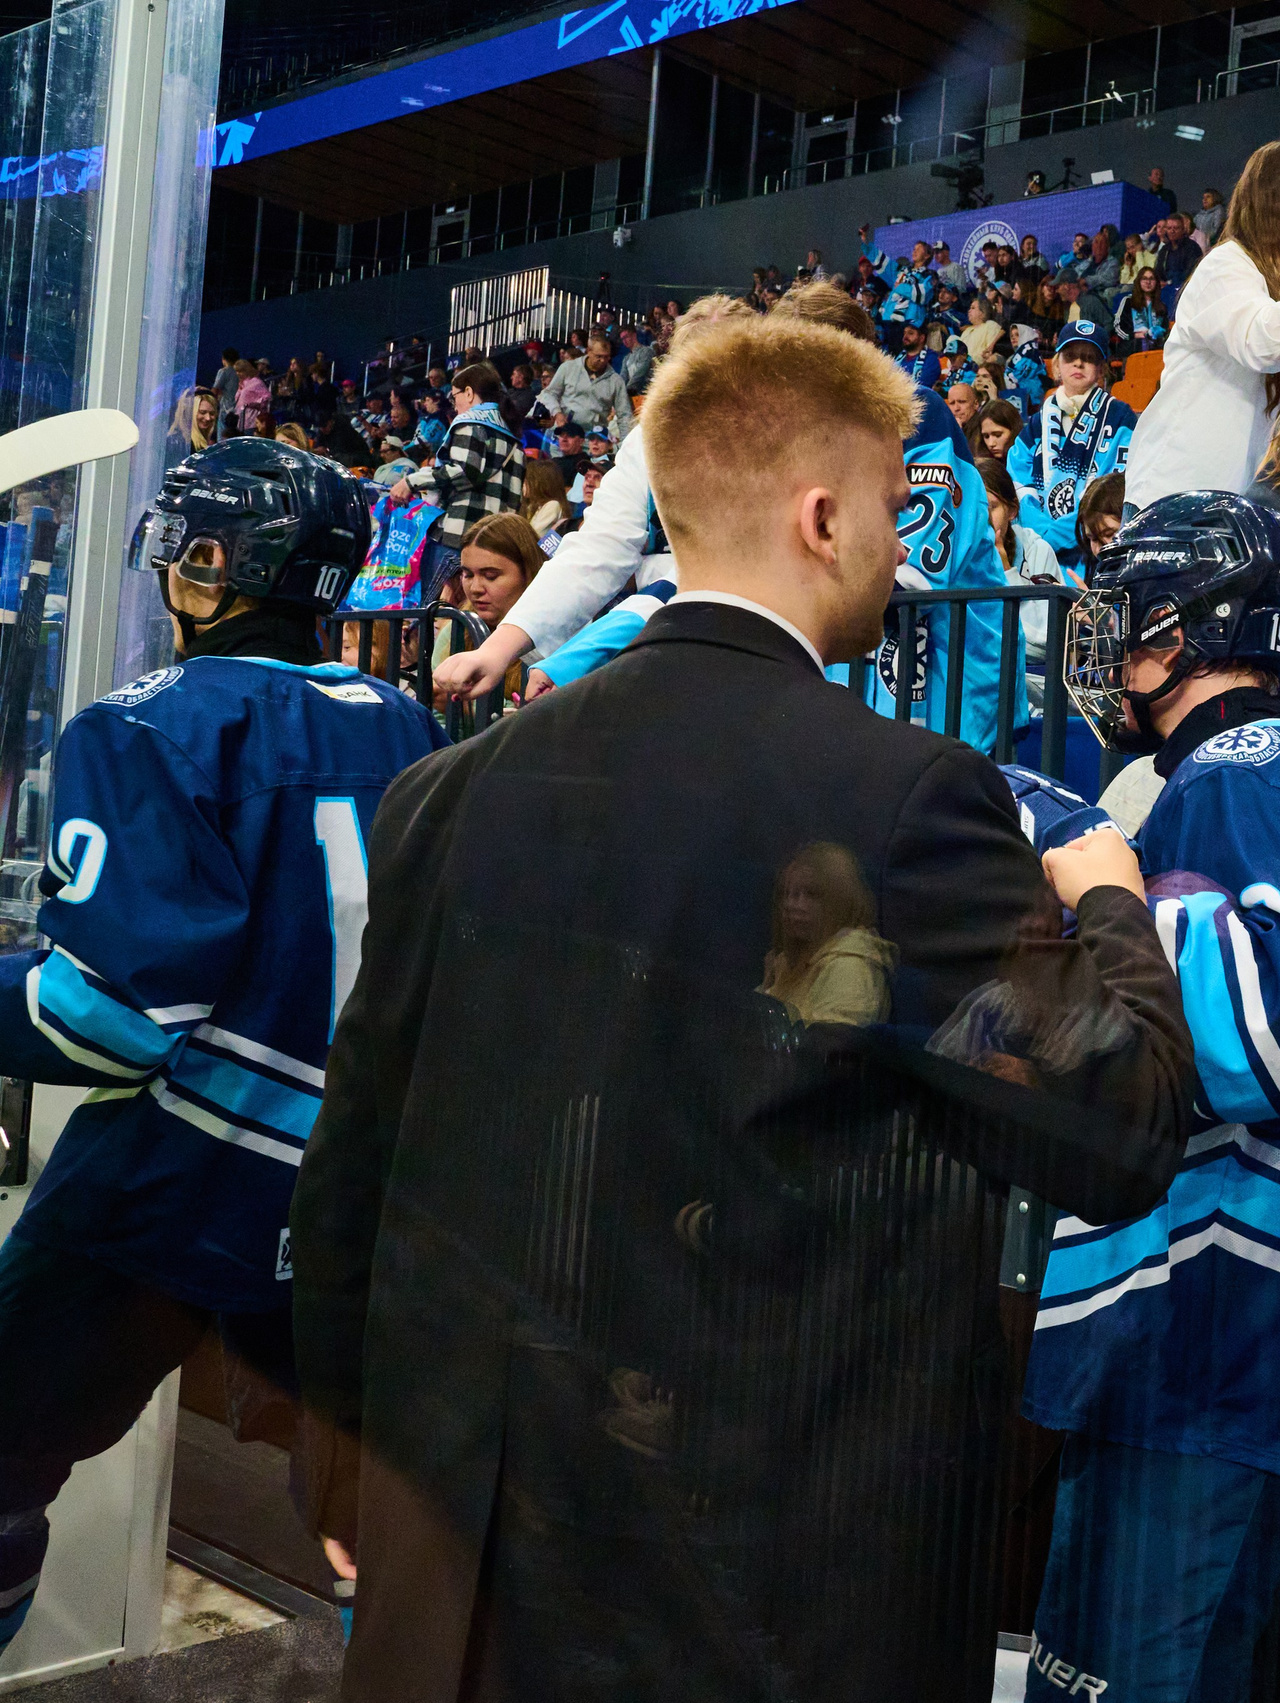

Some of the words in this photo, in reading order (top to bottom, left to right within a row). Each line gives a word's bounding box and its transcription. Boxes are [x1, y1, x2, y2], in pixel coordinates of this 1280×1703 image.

[189, 488, 240, 505] BAUER
[896, 493, 957, 574] 23
[151, 557, 169, 566] CCM
[1133, 551, 1186, 563] BAUER
[314, 565, 342, 601] 10
[1140, 613, 1180, 642] BAUER
[881, 637, 898, 663] SIBI
